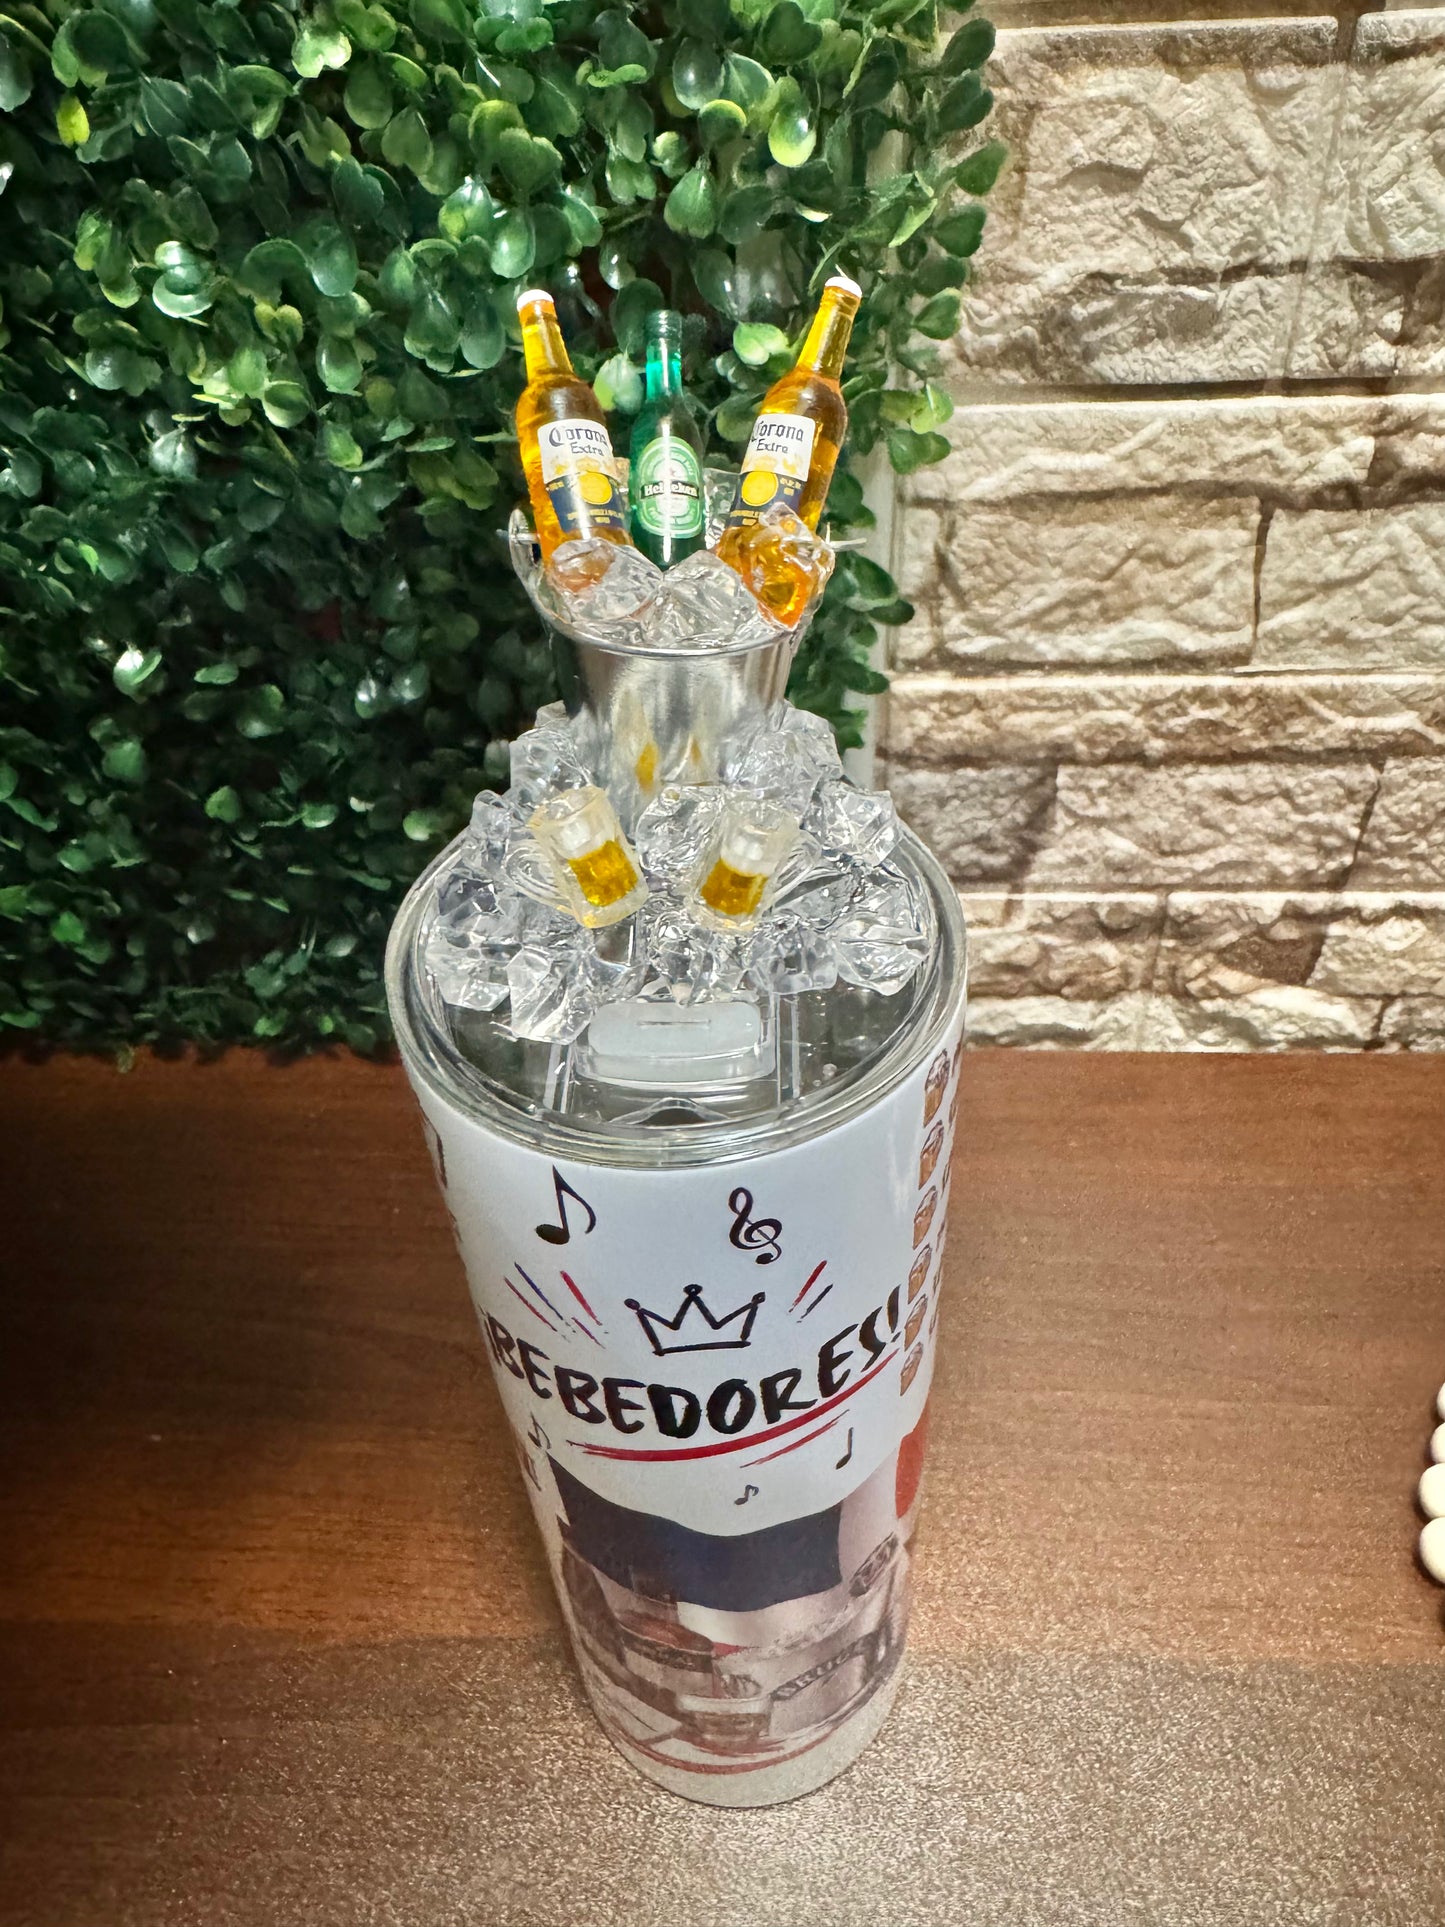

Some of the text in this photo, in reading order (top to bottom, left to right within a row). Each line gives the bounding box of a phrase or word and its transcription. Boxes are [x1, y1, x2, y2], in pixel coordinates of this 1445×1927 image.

[548, 426, 608, 448] Corona
[570, 441, 604, 457] Extra
[643, 481, 699, 498] Heieken
